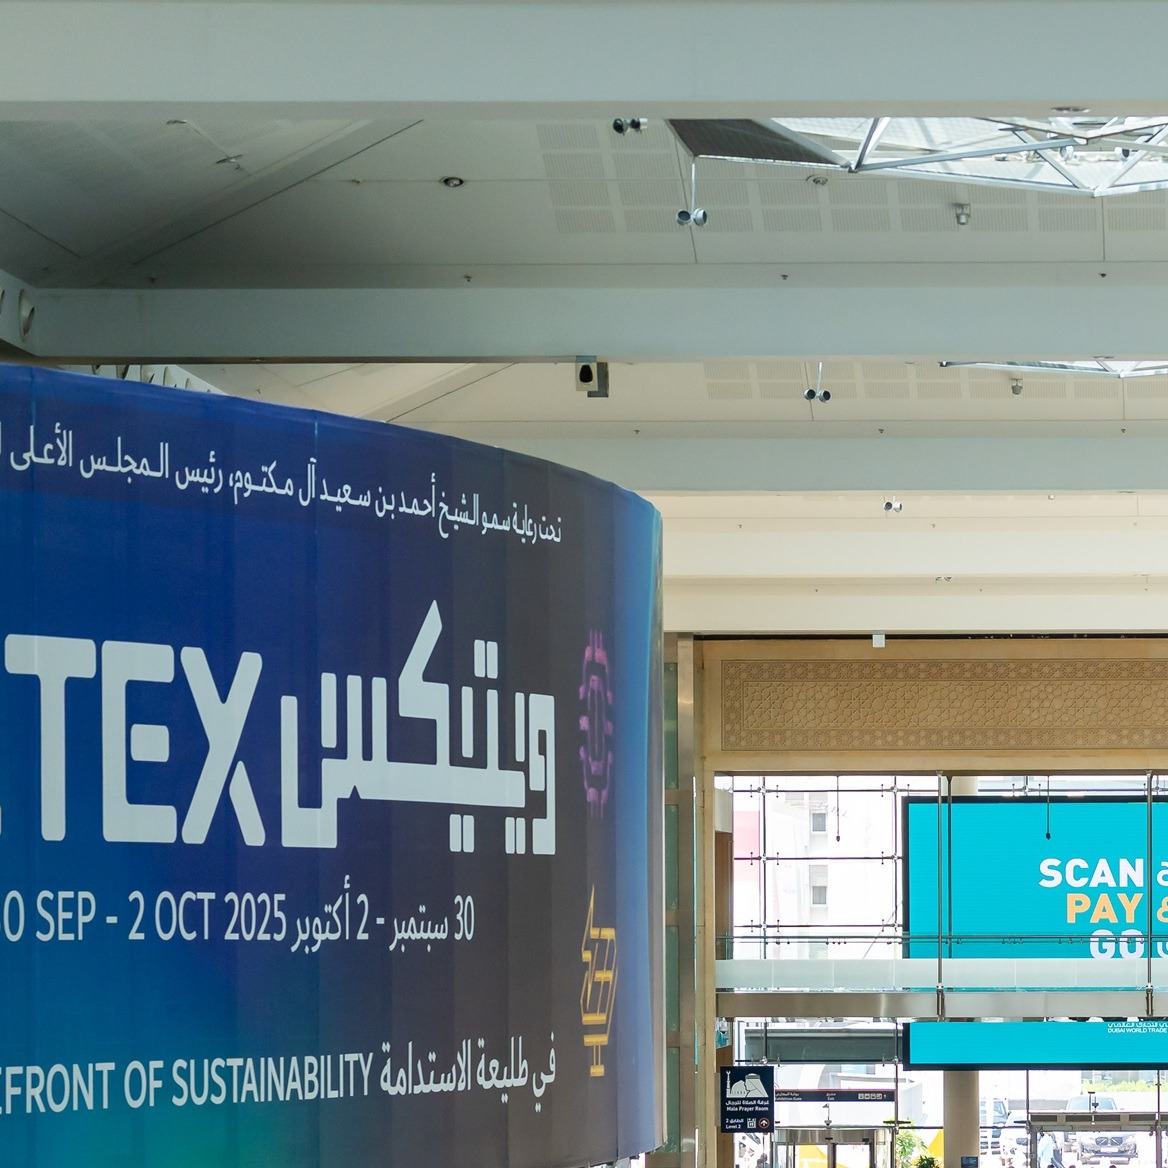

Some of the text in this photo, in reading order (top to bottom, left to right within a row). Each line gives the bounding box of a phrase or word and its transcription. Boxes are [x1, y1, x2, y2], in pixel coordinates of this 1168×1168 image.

[10, 422, 73, 471] الأعلى
[79, 436, 169, 484] المجلس
[175, 450, 223, 494] رئيس
[298, 457, 317, 507] آل
[319, 478, 371, 512] سعيد
[398, 472, 436, 518] أحمد
[375, 486, 396, 520] بن
[438, 491, 479, 539] الشيخ
[481, 511, 511, 535] سمو
[512, 502, 537, 545] رعاية
[0, 633, 266, 847] TEX
[280, 600, 556, 855] ويتيكس
[1038, 858, 1145, 888] SCAN
[2, 890, 25, 942] 0
[35, 890, 96, 942] SEP
[128, 890, 145, 940] 2
[155, 890, 216, 941] OCT
[224, 891, 287, 942] 2025
[290, 874, 351, 954] أكتوبر
[356, 893, 369, 940] 2
[388, 904, 449, 953] سبتمبر
[454, 894, 475, 941] 30
[1066, 893, 1144, 924] PAY
[1089, 929, 1145, 960] GO
[0, 1052, 374, 1115] FRONT OF SUSTAINABILITY
[380, 1031, 557, 1113] في طليعة الاستدامة
